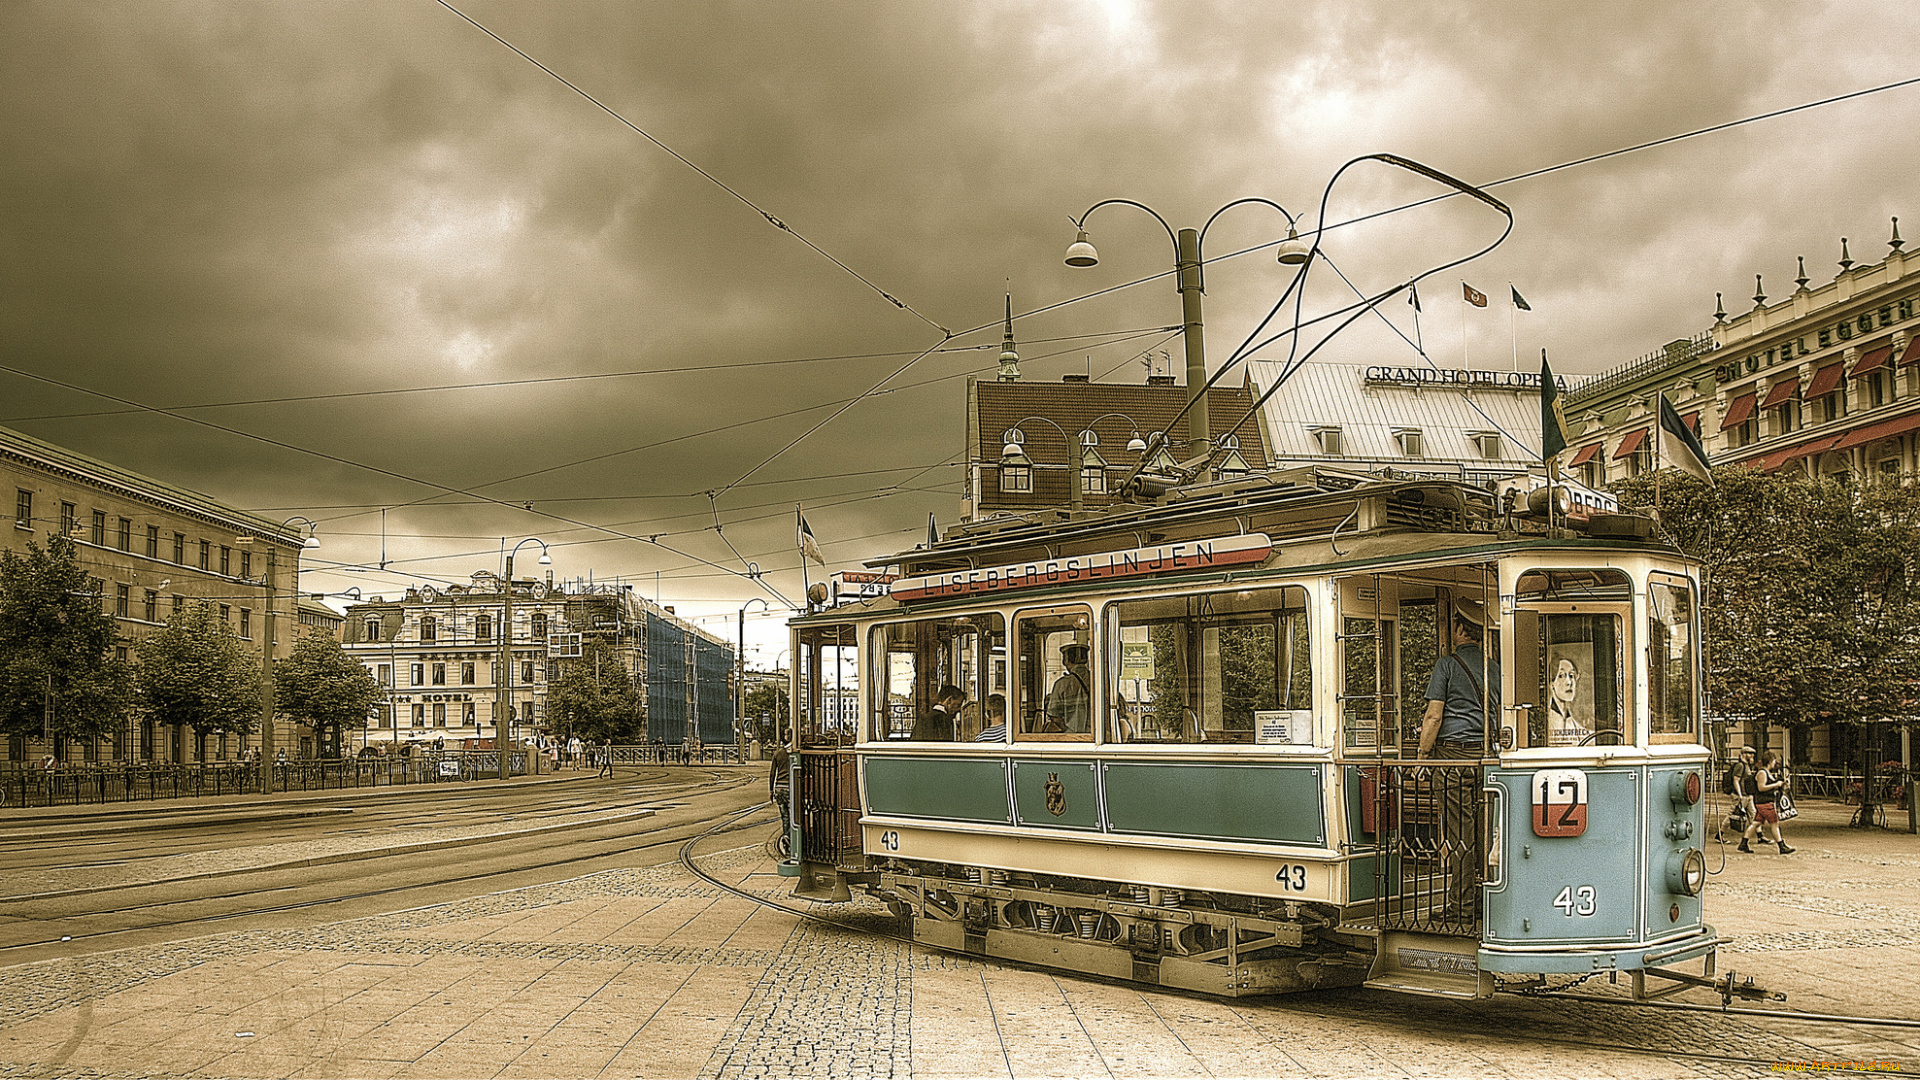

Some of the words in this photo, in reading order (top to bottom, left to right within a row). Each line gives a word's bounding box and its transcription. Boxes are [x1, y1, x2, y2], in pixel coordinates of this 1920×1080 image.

[1728, 337, 1809, 382] HOTEL
[1818, 293, 1920, 348] EGGER
[1365, 366, 1436, 383] GRAND
[1441, 369, 1503, 385] HOTEL
[1507, 372, 1568, 389] OPEA
[923, 542, 1213, 596] LISEBERGSLINJEN
[421, 693, 473, 702] HOTEL
[1540, 780, 1580, 827] 12
[880, 831, 900, 852] 43
[1275, 863, 1307, 892] 43
[1552, 885, 1597, 917] 43
